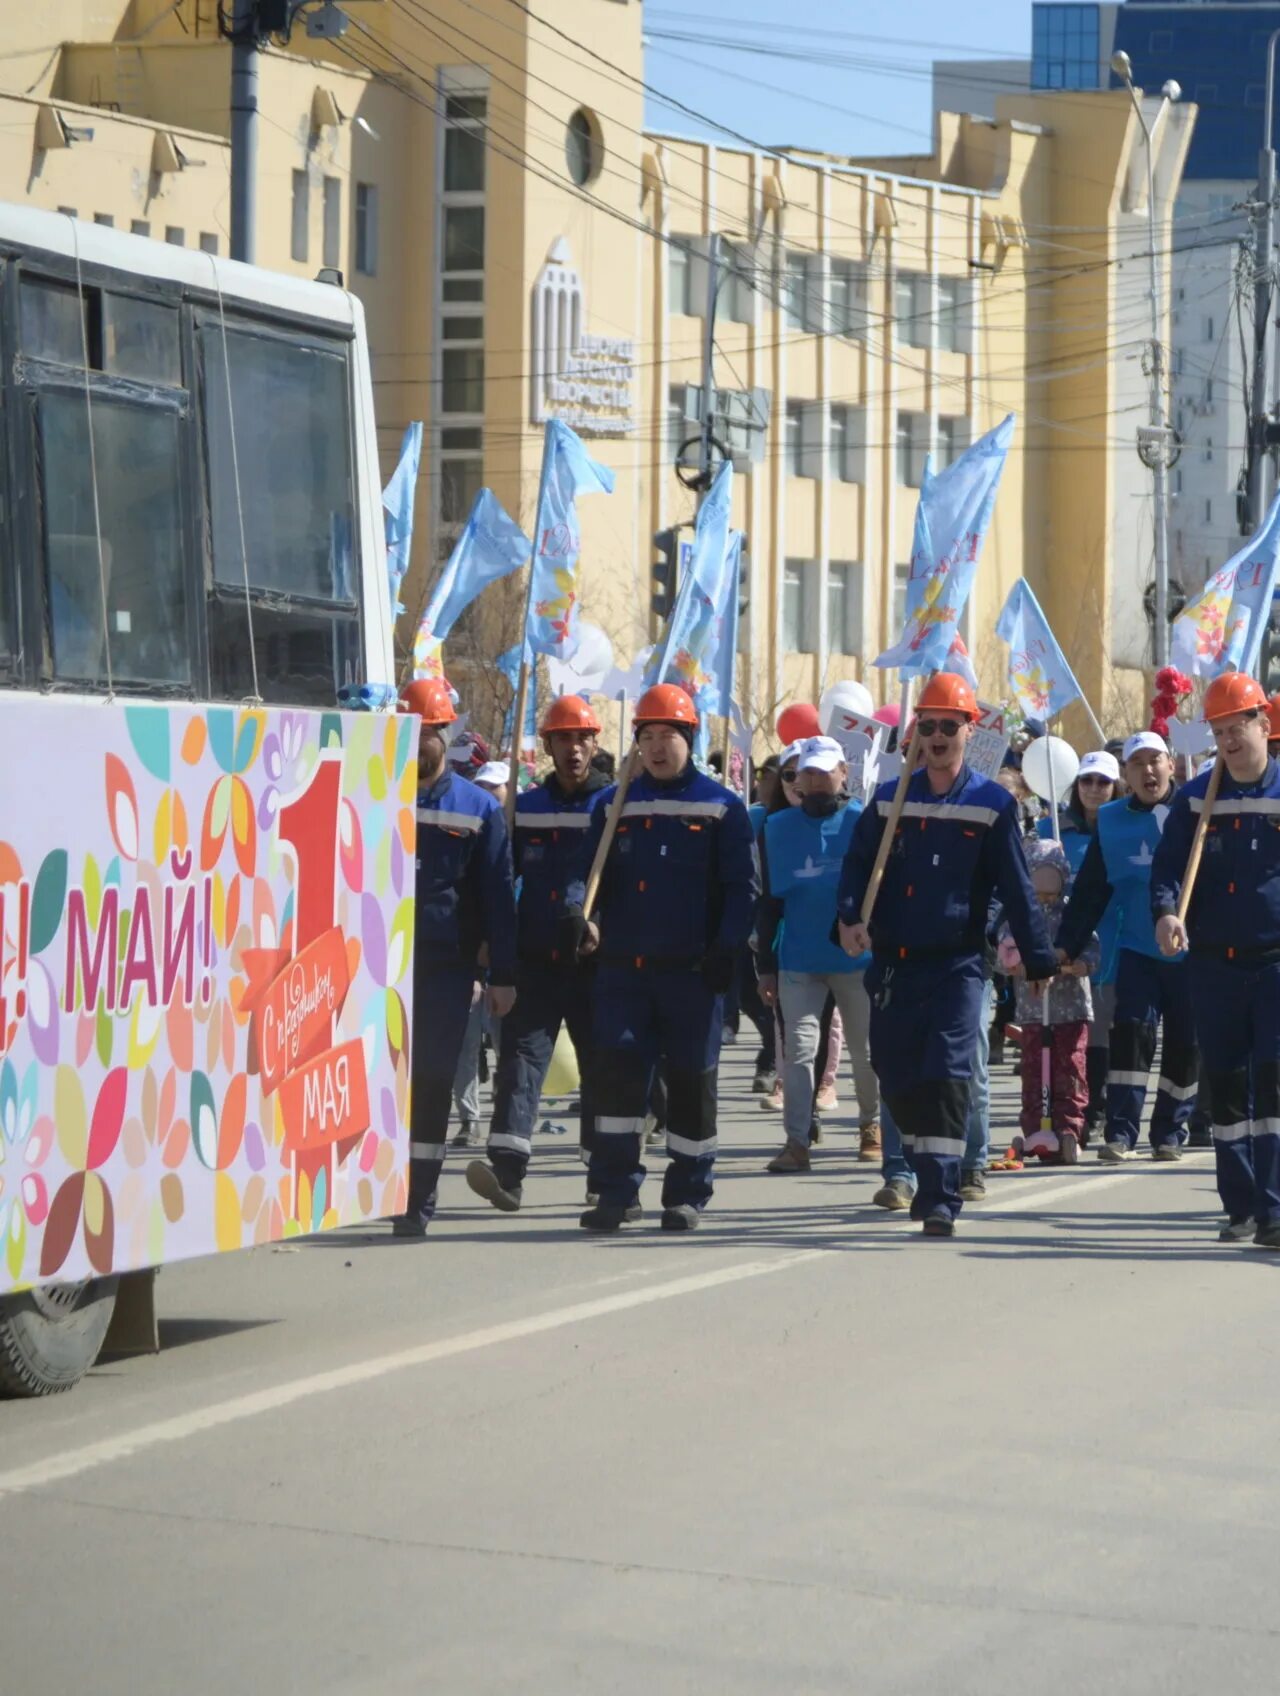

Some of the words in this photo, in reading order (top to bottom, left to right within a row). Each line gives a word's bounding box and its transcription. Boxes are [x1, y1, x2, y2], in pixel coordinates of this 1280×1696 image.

[65, 850, 213, 1013] МАЙ!
[279, 759, 342, 1221] 1
[262, 1004, 277, 1078] С
[302, 1055, 350, 1138] МАЯ
